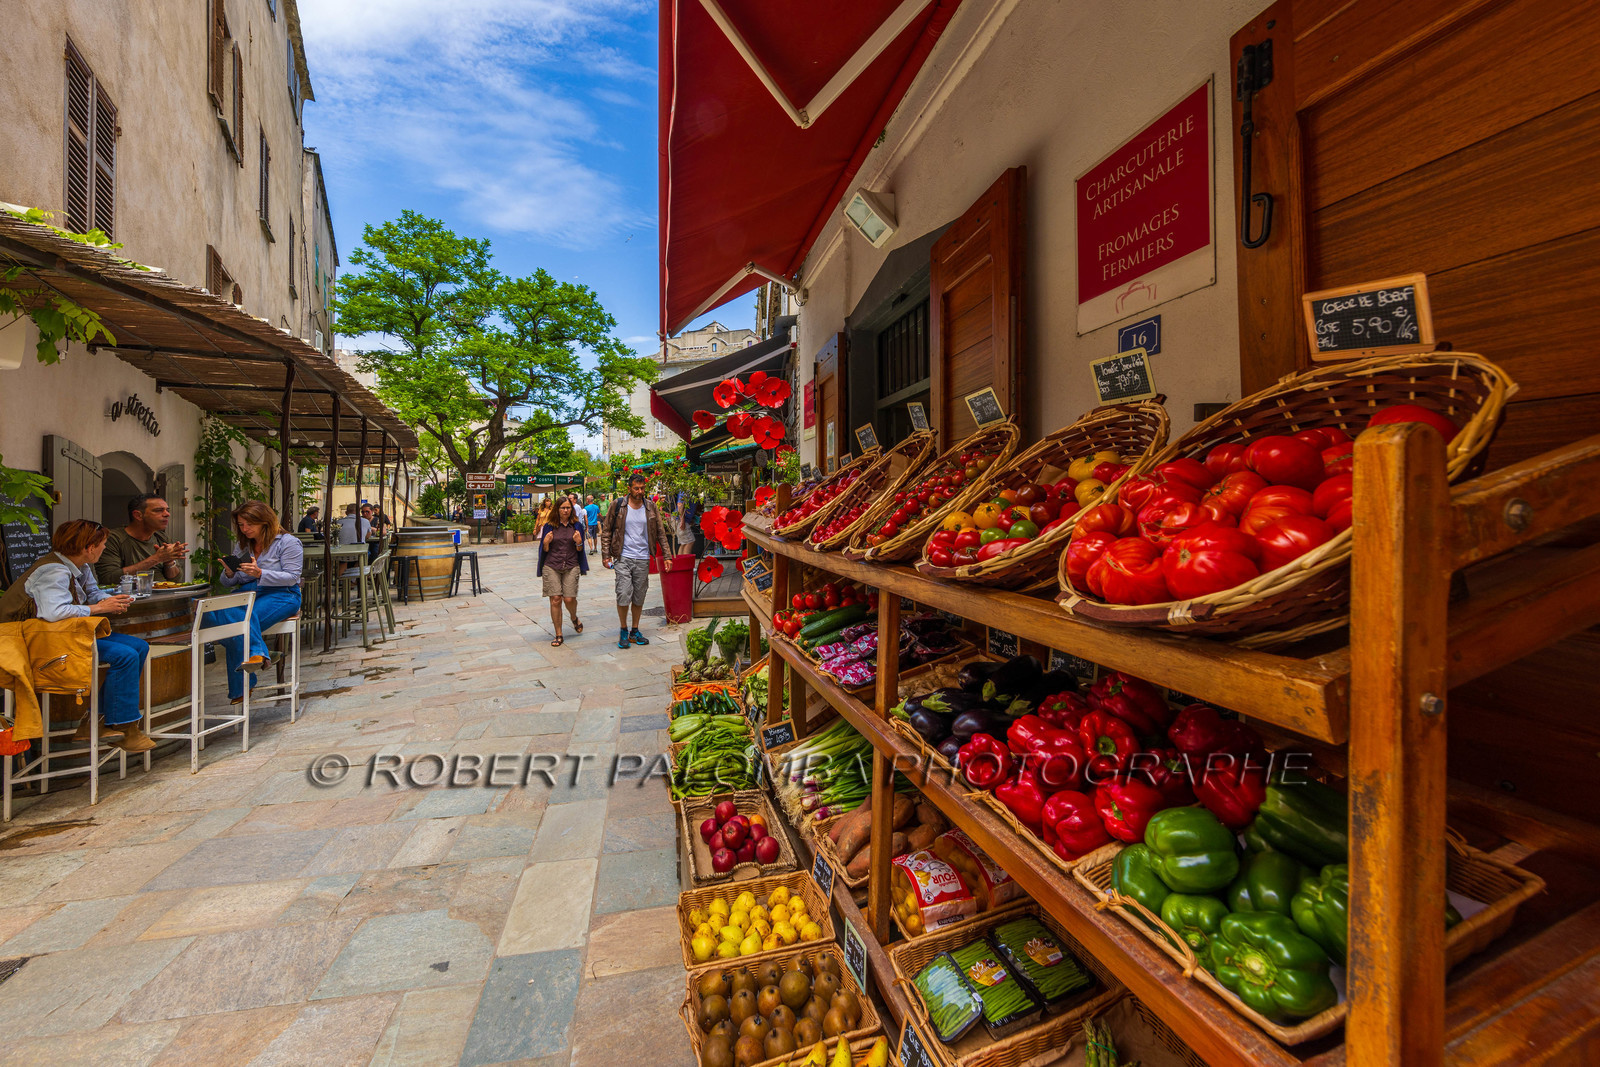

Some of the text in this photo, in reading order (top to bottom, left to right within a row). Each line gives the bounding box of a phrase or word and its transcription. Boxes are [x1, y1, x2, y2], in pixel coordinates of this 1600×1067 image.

[1085, 114, 1194, 201] CHARCUTERIE
[1093, 148, 1184, 220] ARTISANALE
[1098, 204, 1180, 261] FROMAGES
[1102, 232, 1175, 281] FERMIERS
[1130, 330, 1147, 349] 16
[931, 872, 956, 885] FOUR
